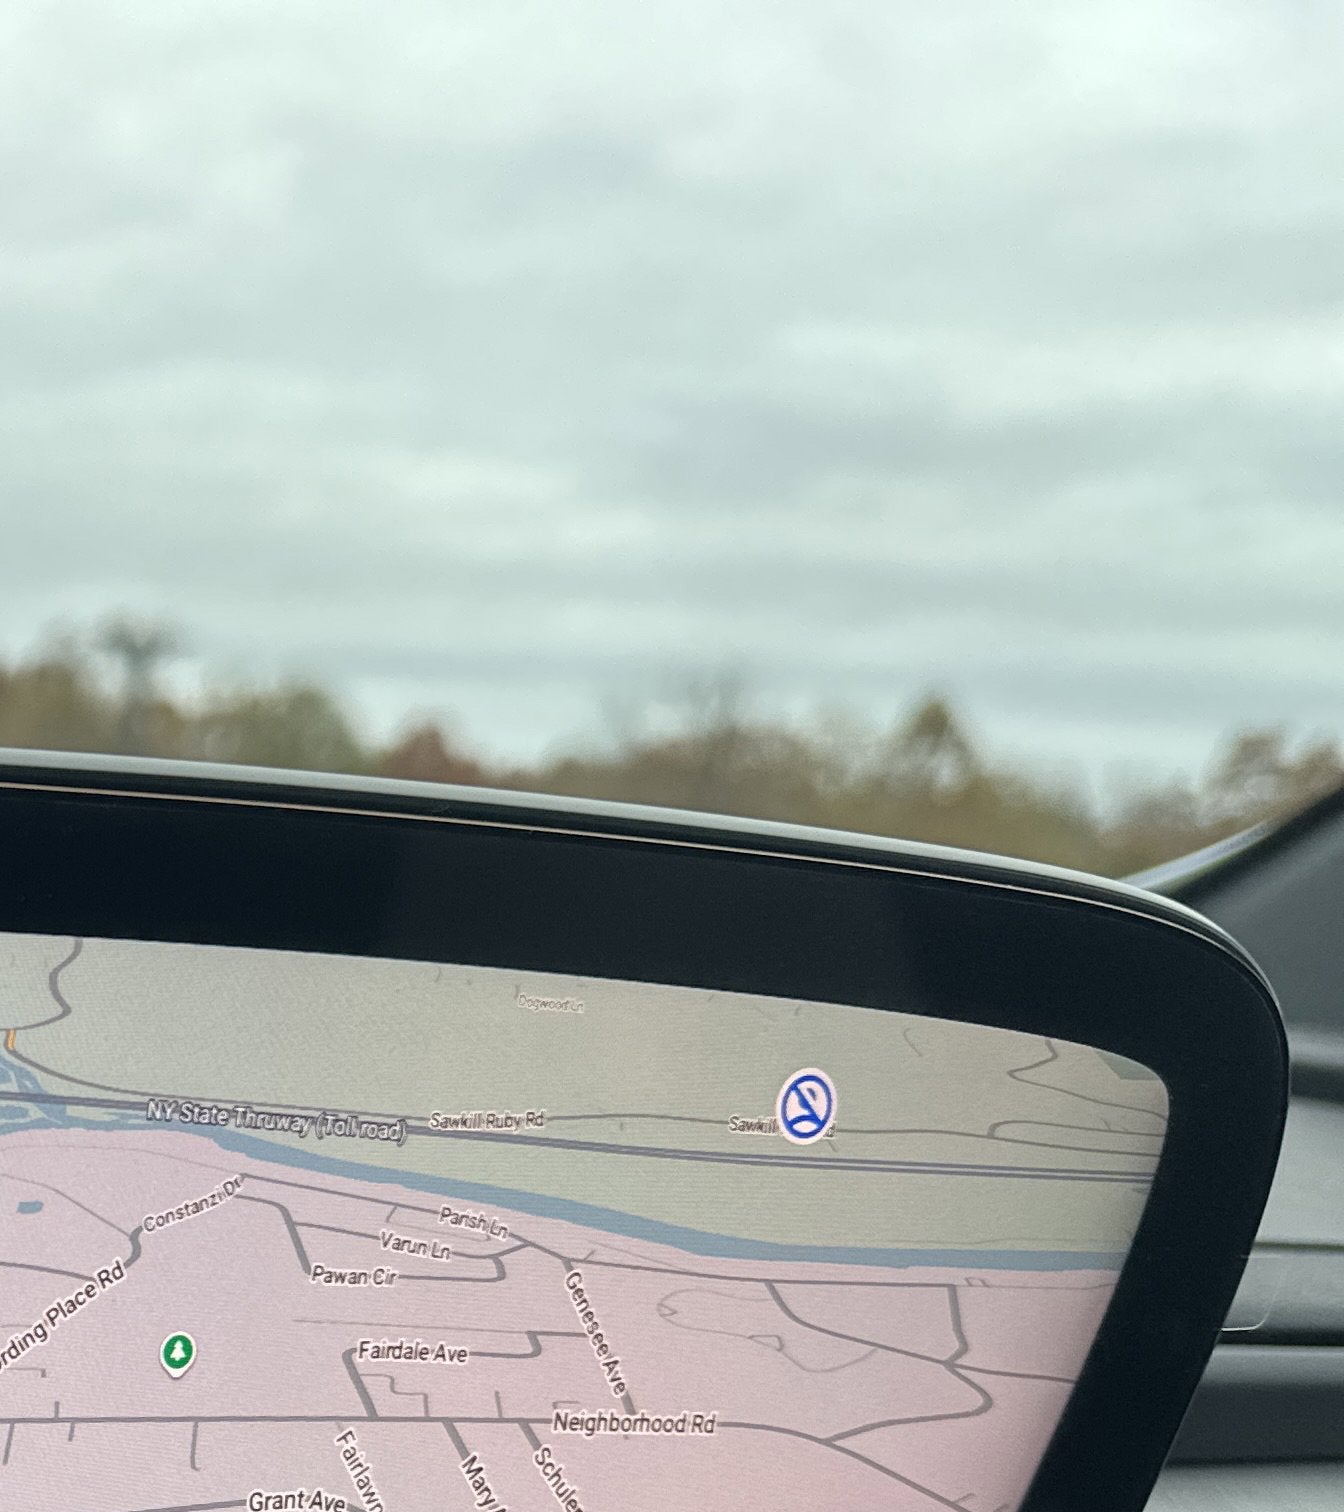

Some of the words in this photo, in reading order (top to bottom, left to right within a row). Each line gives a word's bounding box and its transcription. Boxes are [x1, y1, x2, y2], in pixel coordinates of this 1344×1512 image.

[146, 1099, 174, 1121] NY
[178, 1102, 229, 1126] State
[233, 1106, 312, 1138] Thruway
[314, 1111, 359, 1140] (Toll
[362, 1118, 409, 1146] road)
[430, 1112, 481, 1130] Sawkill
[486, 1112, 521, 1137] Ruby
[526, 1111, 545, 1128] Rd
[143, 1188, 226, 1232] Constanzi
[223, 1176, 242, 1197] Dr
[440, 1206, 487, 1232] Parish
[489, 1220, 509, 1239] Ln
[380, 1231, 427, 1256] Varun
[431, 1240, 451, 1259] Ln
[311, 1264, 368, 1285] Pawan
[372, 1267, 399, 1286] Cir
[45, 1283, 98, 1328] Place
[97, 1260, 126, 1290] Rd
[564, 1271, 610, 1356] Genesee
[602, 1357, 627, 1395] Ave
[358, 1339, 430, 1361] Fairdale
[431, 1342, 469, 1364] Ave
[553, 1412, 687, 1438] Neighborhood
[691, 1413, 717, 1435] Rd
[462, 1454, 498, 1509] Mary
[248, 1491, 305, 1512] Grant
